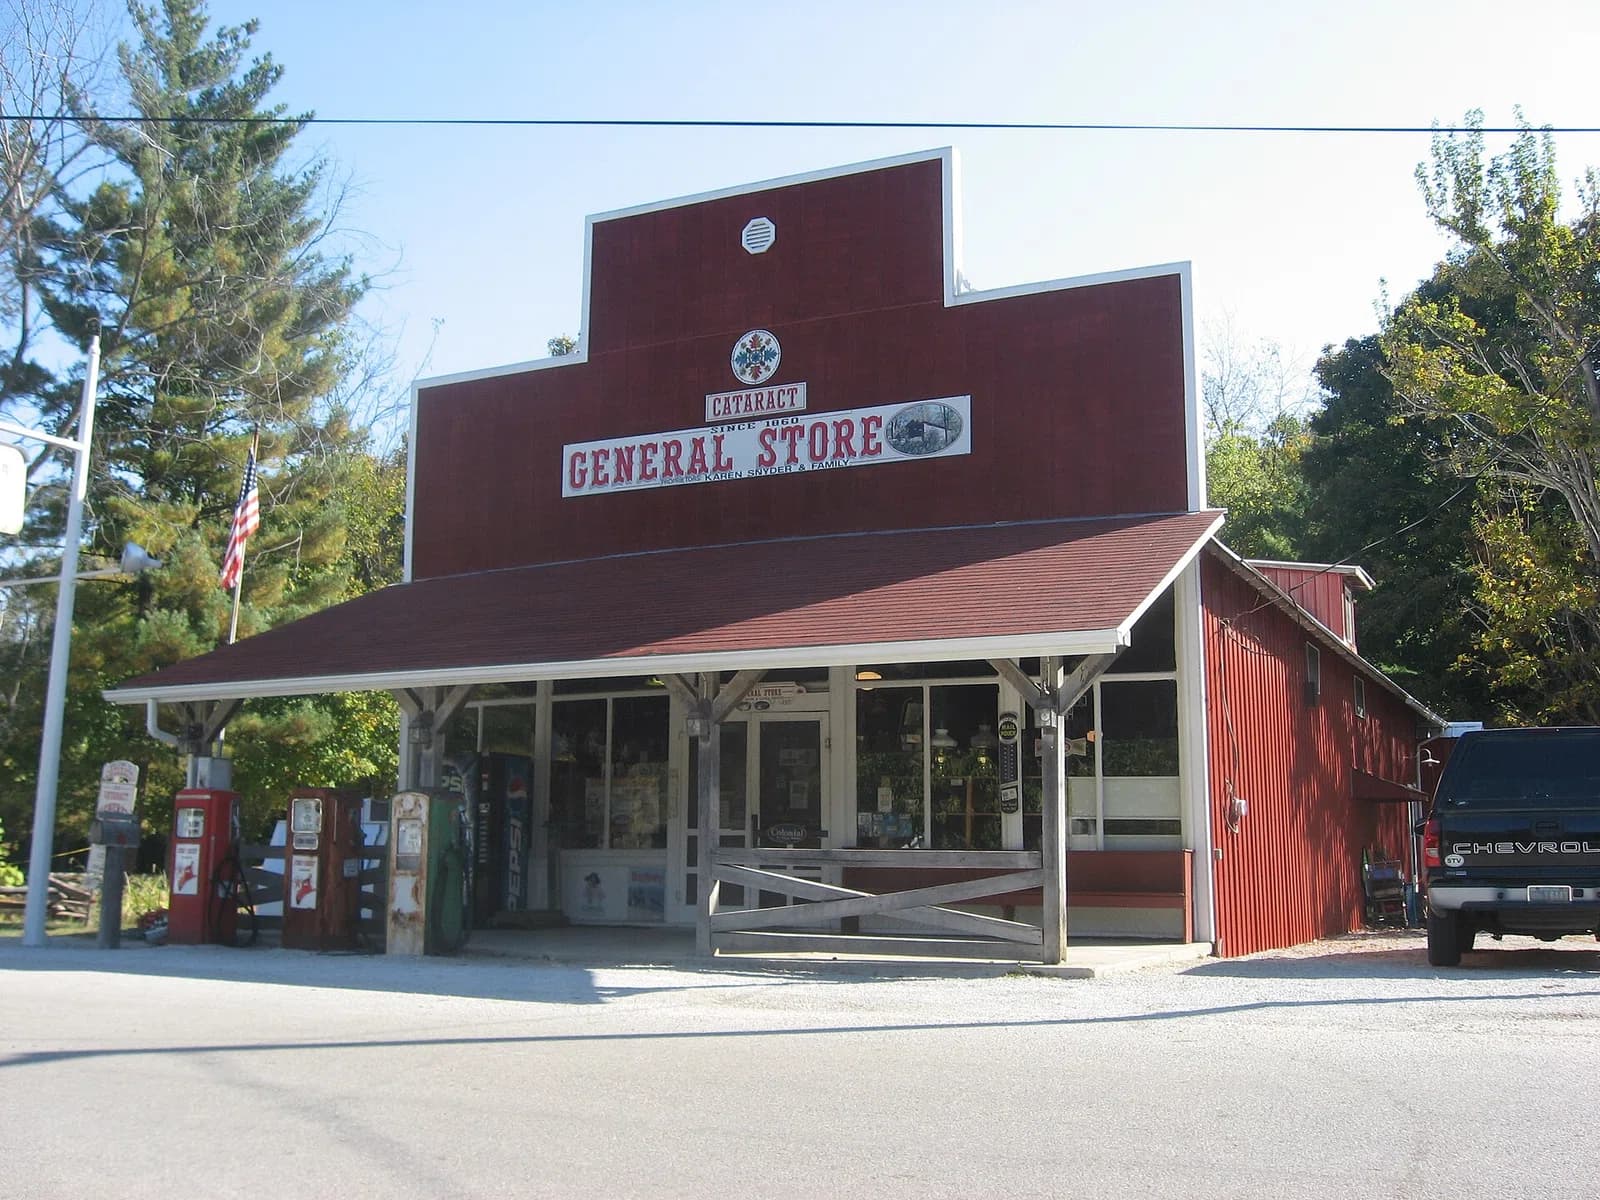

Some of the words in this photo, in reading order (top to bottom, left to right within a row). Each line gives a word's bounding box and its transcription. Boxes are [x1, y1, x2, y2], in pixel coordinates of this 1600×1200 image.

[713, 387, 798, 417] CATARACT
[710, 422, 756, 434] SINCE
[569, 433, 733, 489] GENERAL
[758, 415, 883, 468] STORE
[704, 470, 743, 481] KAREN
[747, 464, 792, 478] SNYDER
[798, 464, 806, 472] &
[811, 458, 850, 470] FAMILY
